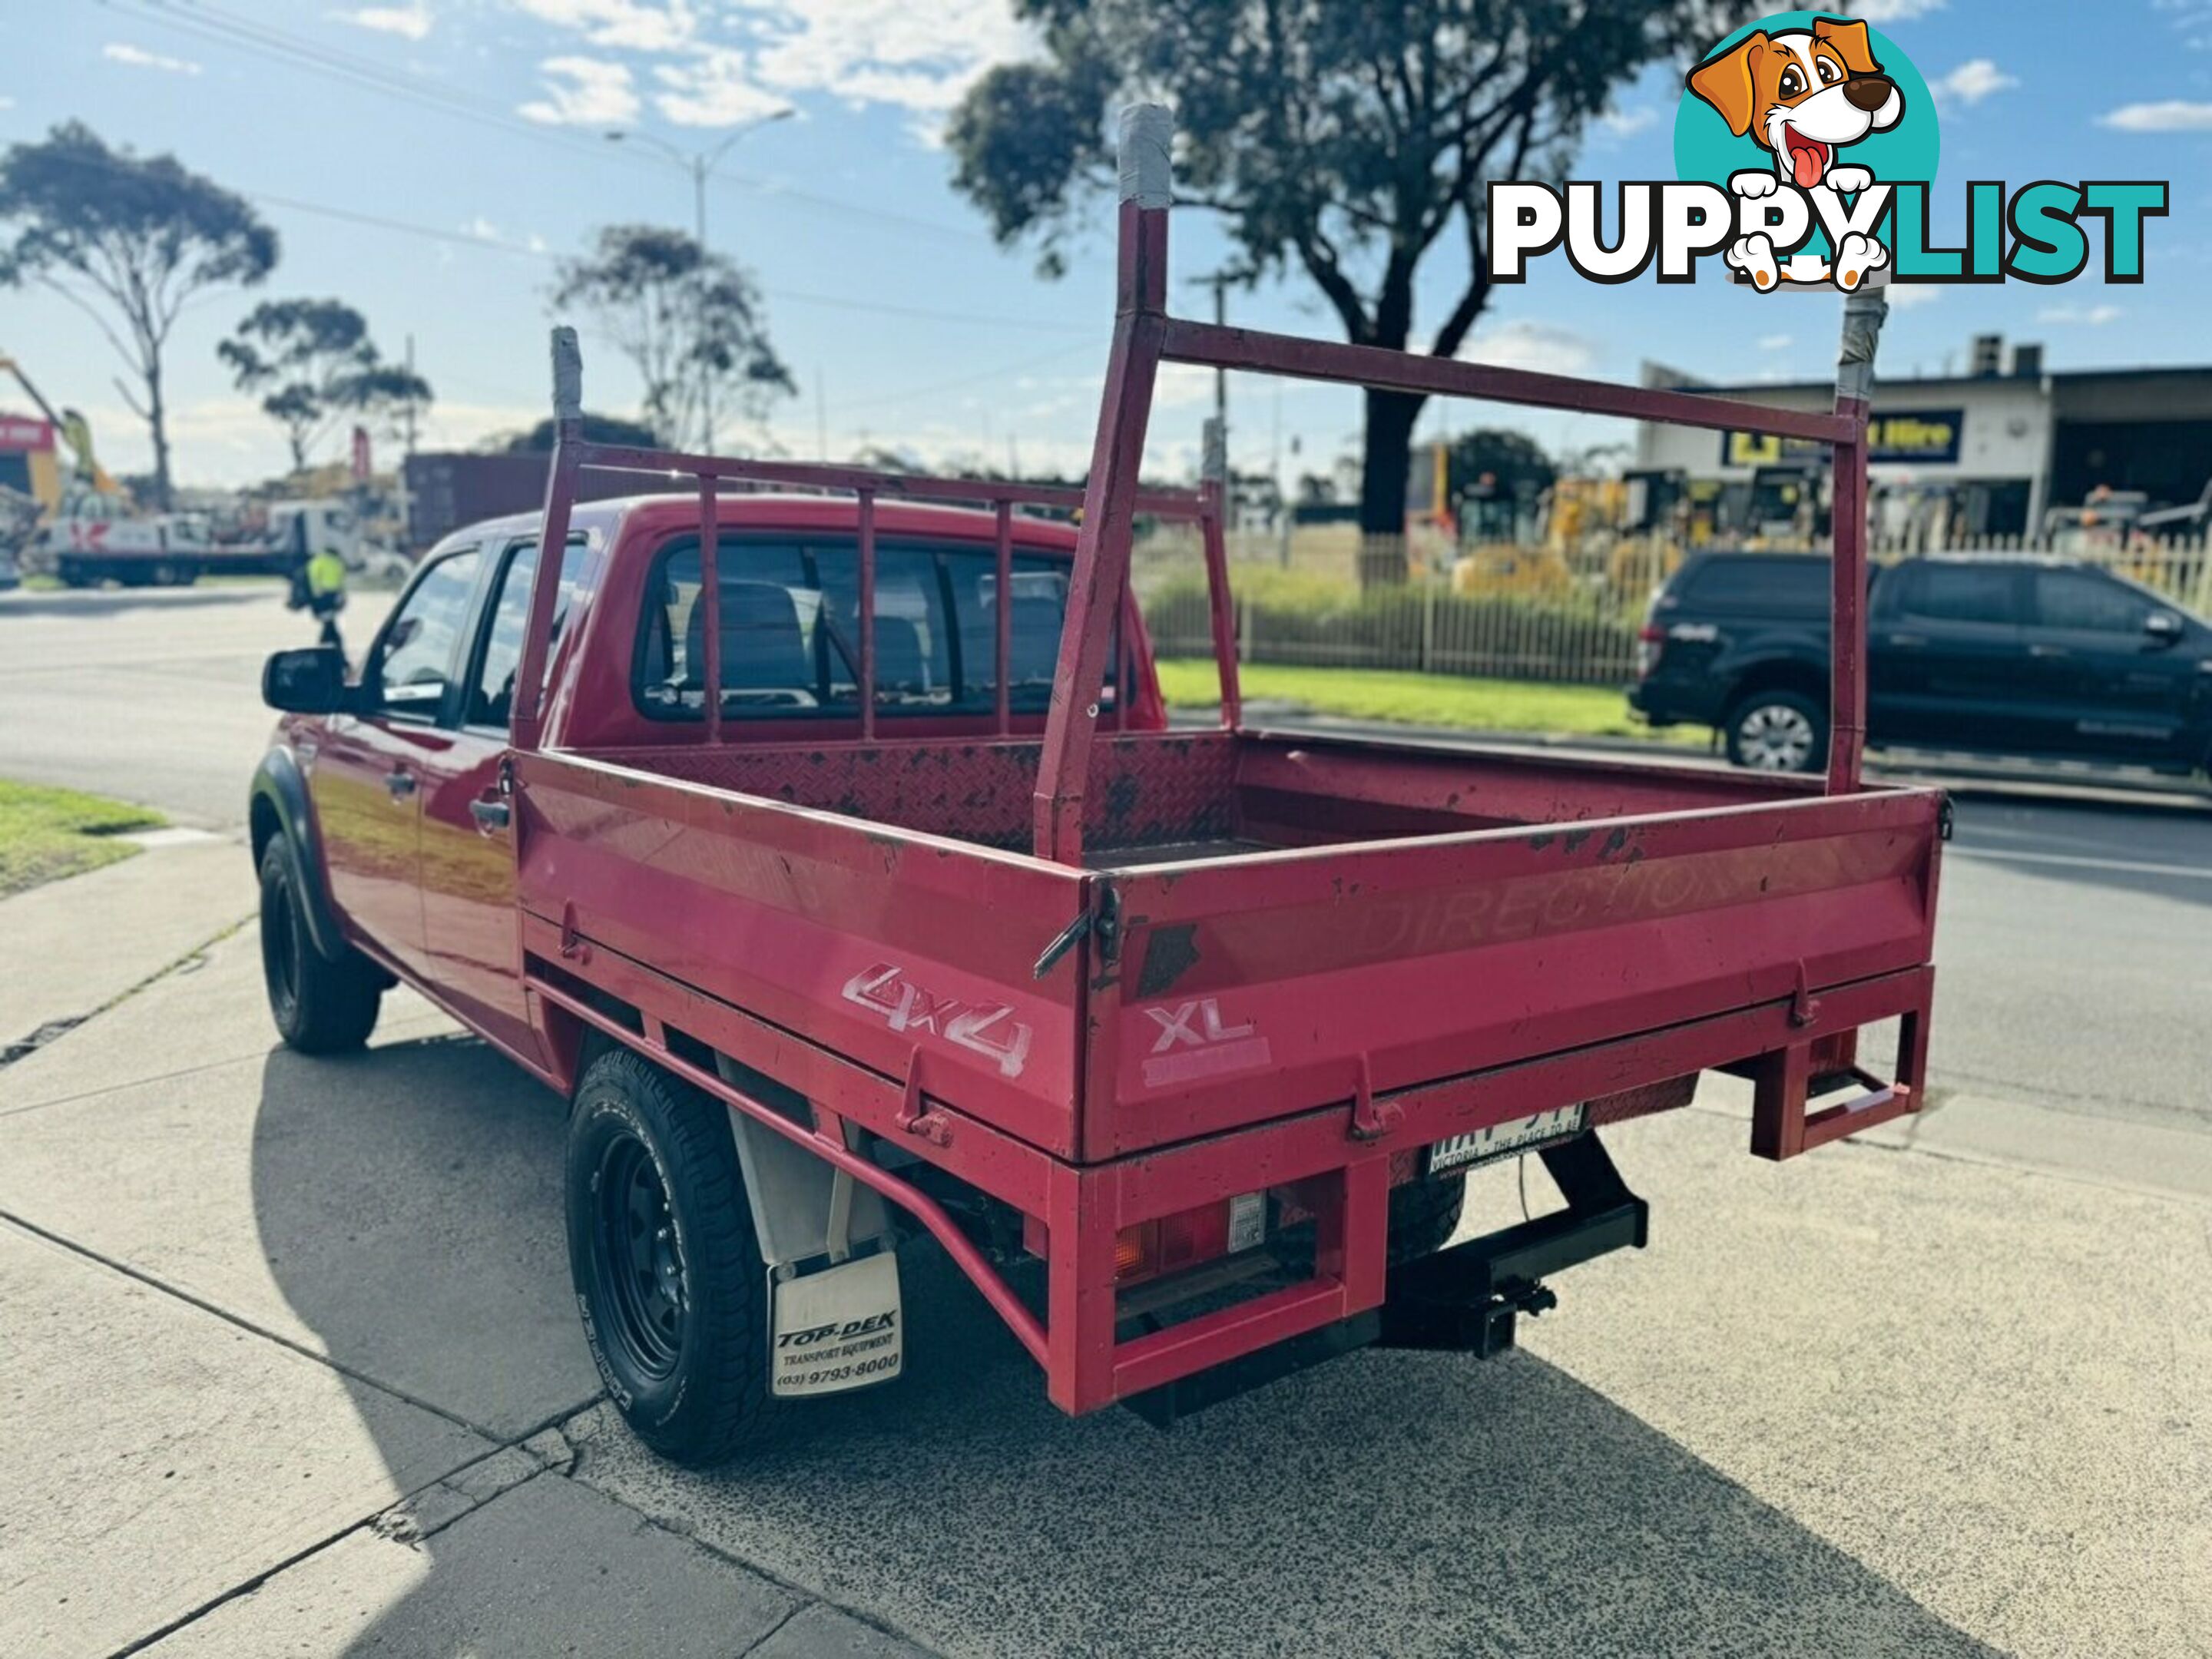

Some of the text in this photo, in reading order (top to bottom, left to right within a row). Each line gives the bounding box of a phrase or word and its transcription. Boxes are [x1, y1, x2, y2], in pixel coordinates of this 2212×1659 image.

[1143, 998, 1254, 1054] XL
[1432, 1147, 1479, 1172] VICTORIA
[1494, 1137, 1513, 1152] THE
[1517, 1128, 1546, 1144] PLACE
[1550, 1122, 1562, 1135] TO
[777, 1309, 898, 1349] TOP-DEK
[784, 1333, 895, 1366] TRANSPORT EQUIPMENT
[777, 1374, 805, 1387] (03)
